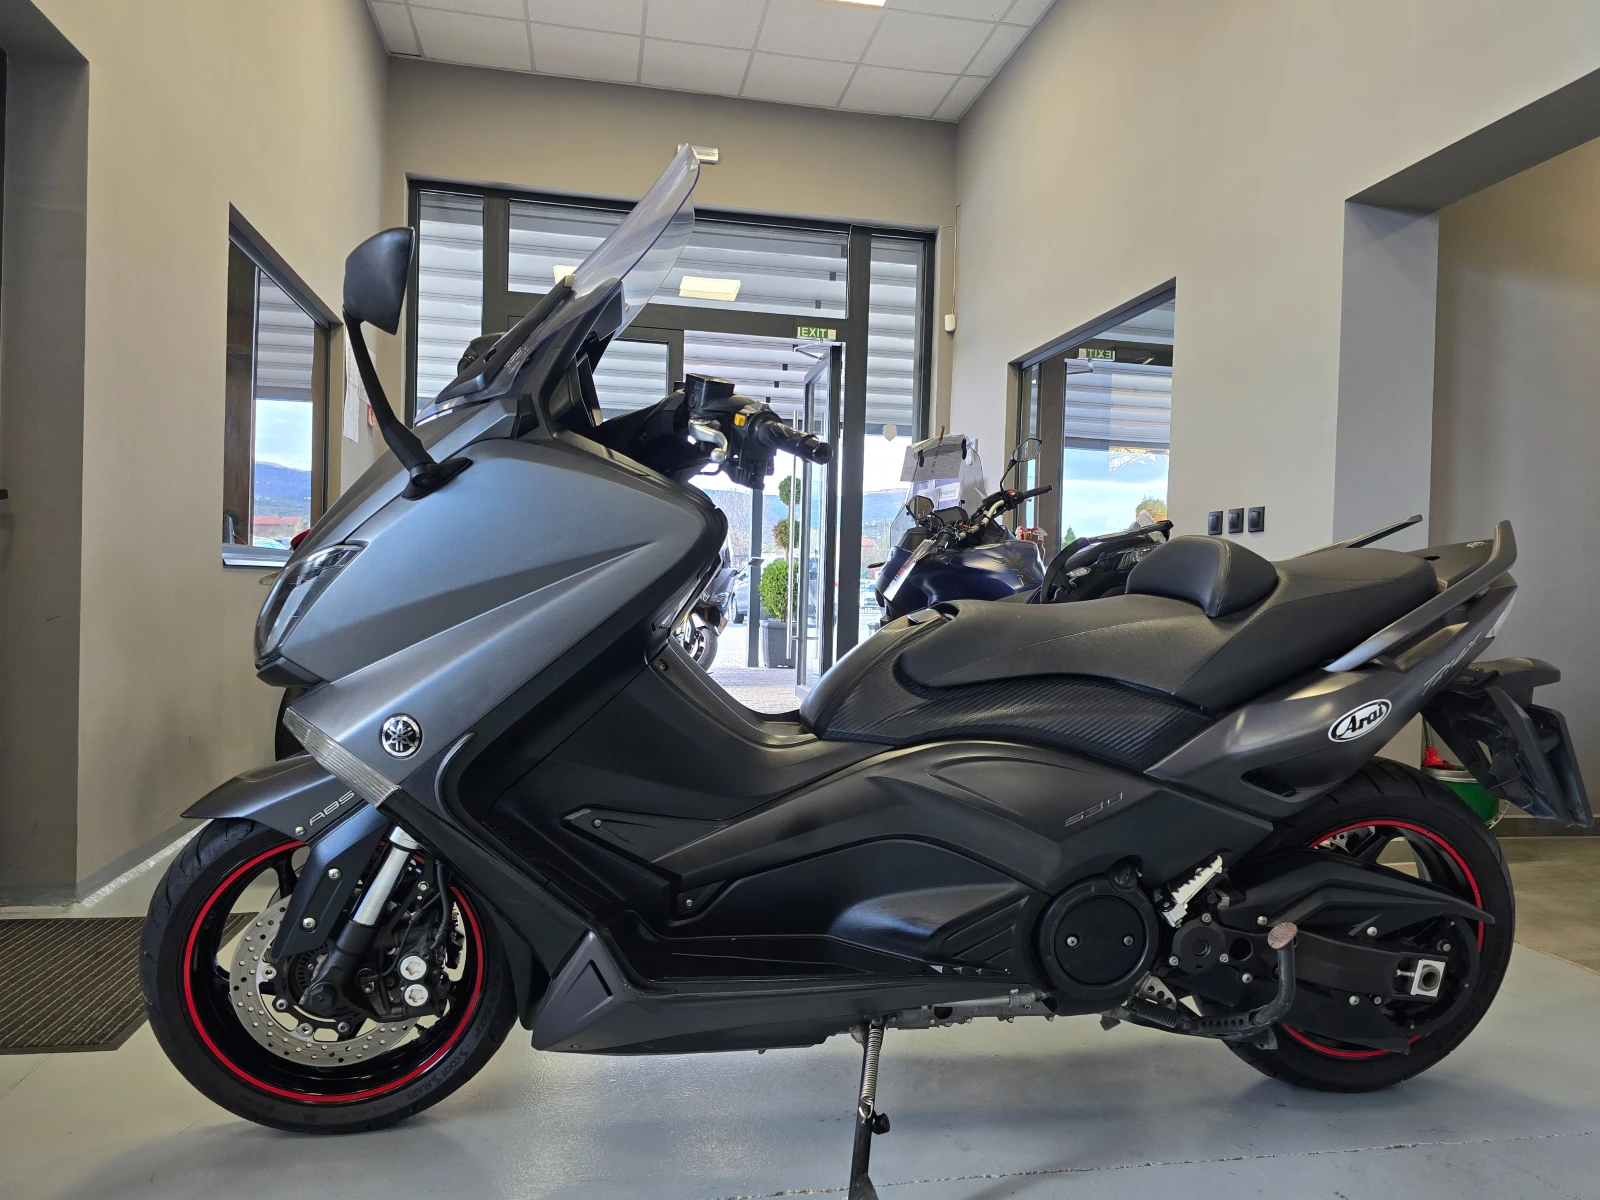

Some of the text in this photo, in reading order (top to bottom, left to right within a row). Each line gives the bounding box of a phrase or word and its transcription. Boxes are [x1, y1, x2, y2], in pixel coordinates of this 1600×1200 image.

[801, 326, 827, 338] EXIT
[1335, 701, 1384, 739] Arai
[309, 790, 355, 827] ABS
[1064, 791, 1123, 827] 530
